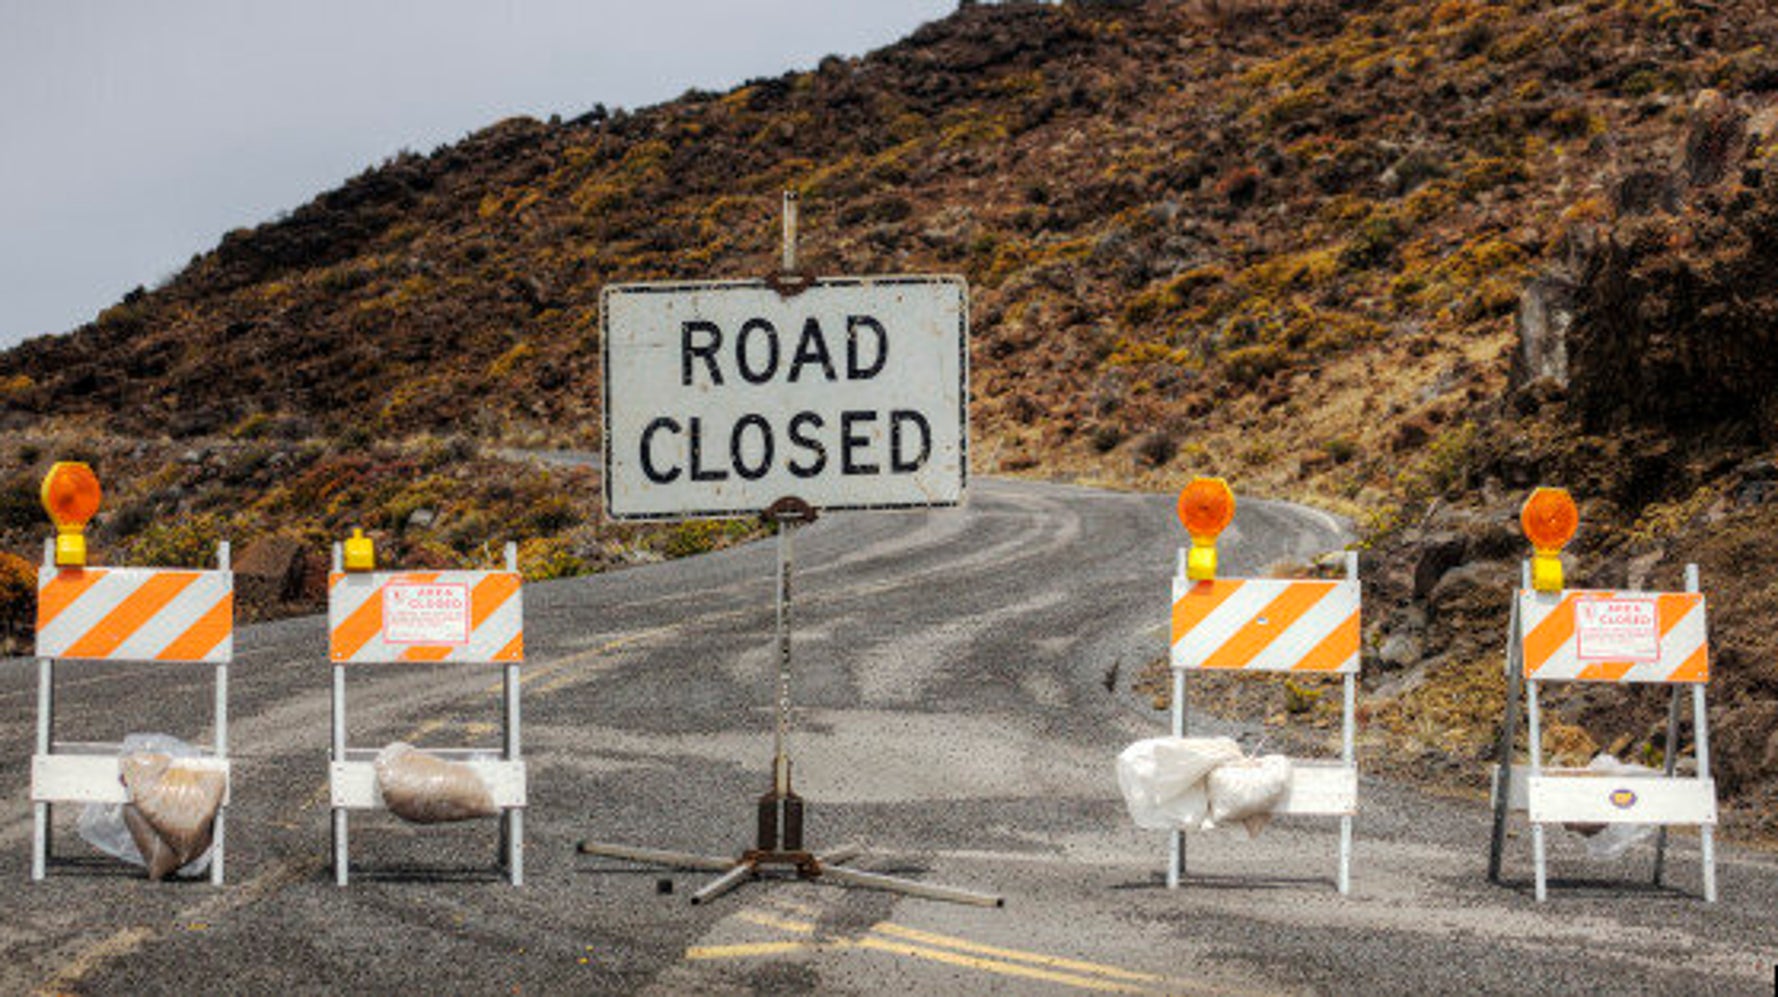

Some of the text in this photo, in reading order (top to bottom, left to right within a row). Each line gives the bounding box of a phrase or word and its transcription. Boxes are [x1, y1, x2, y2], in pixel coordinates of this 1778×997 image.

[681, 315, 888, 386] ROAD
[639, 409, 931, 484] CLOSED
[408, 598, 463, 609] CLOSED
[1599, 614, 1652, 625] CLOSED
